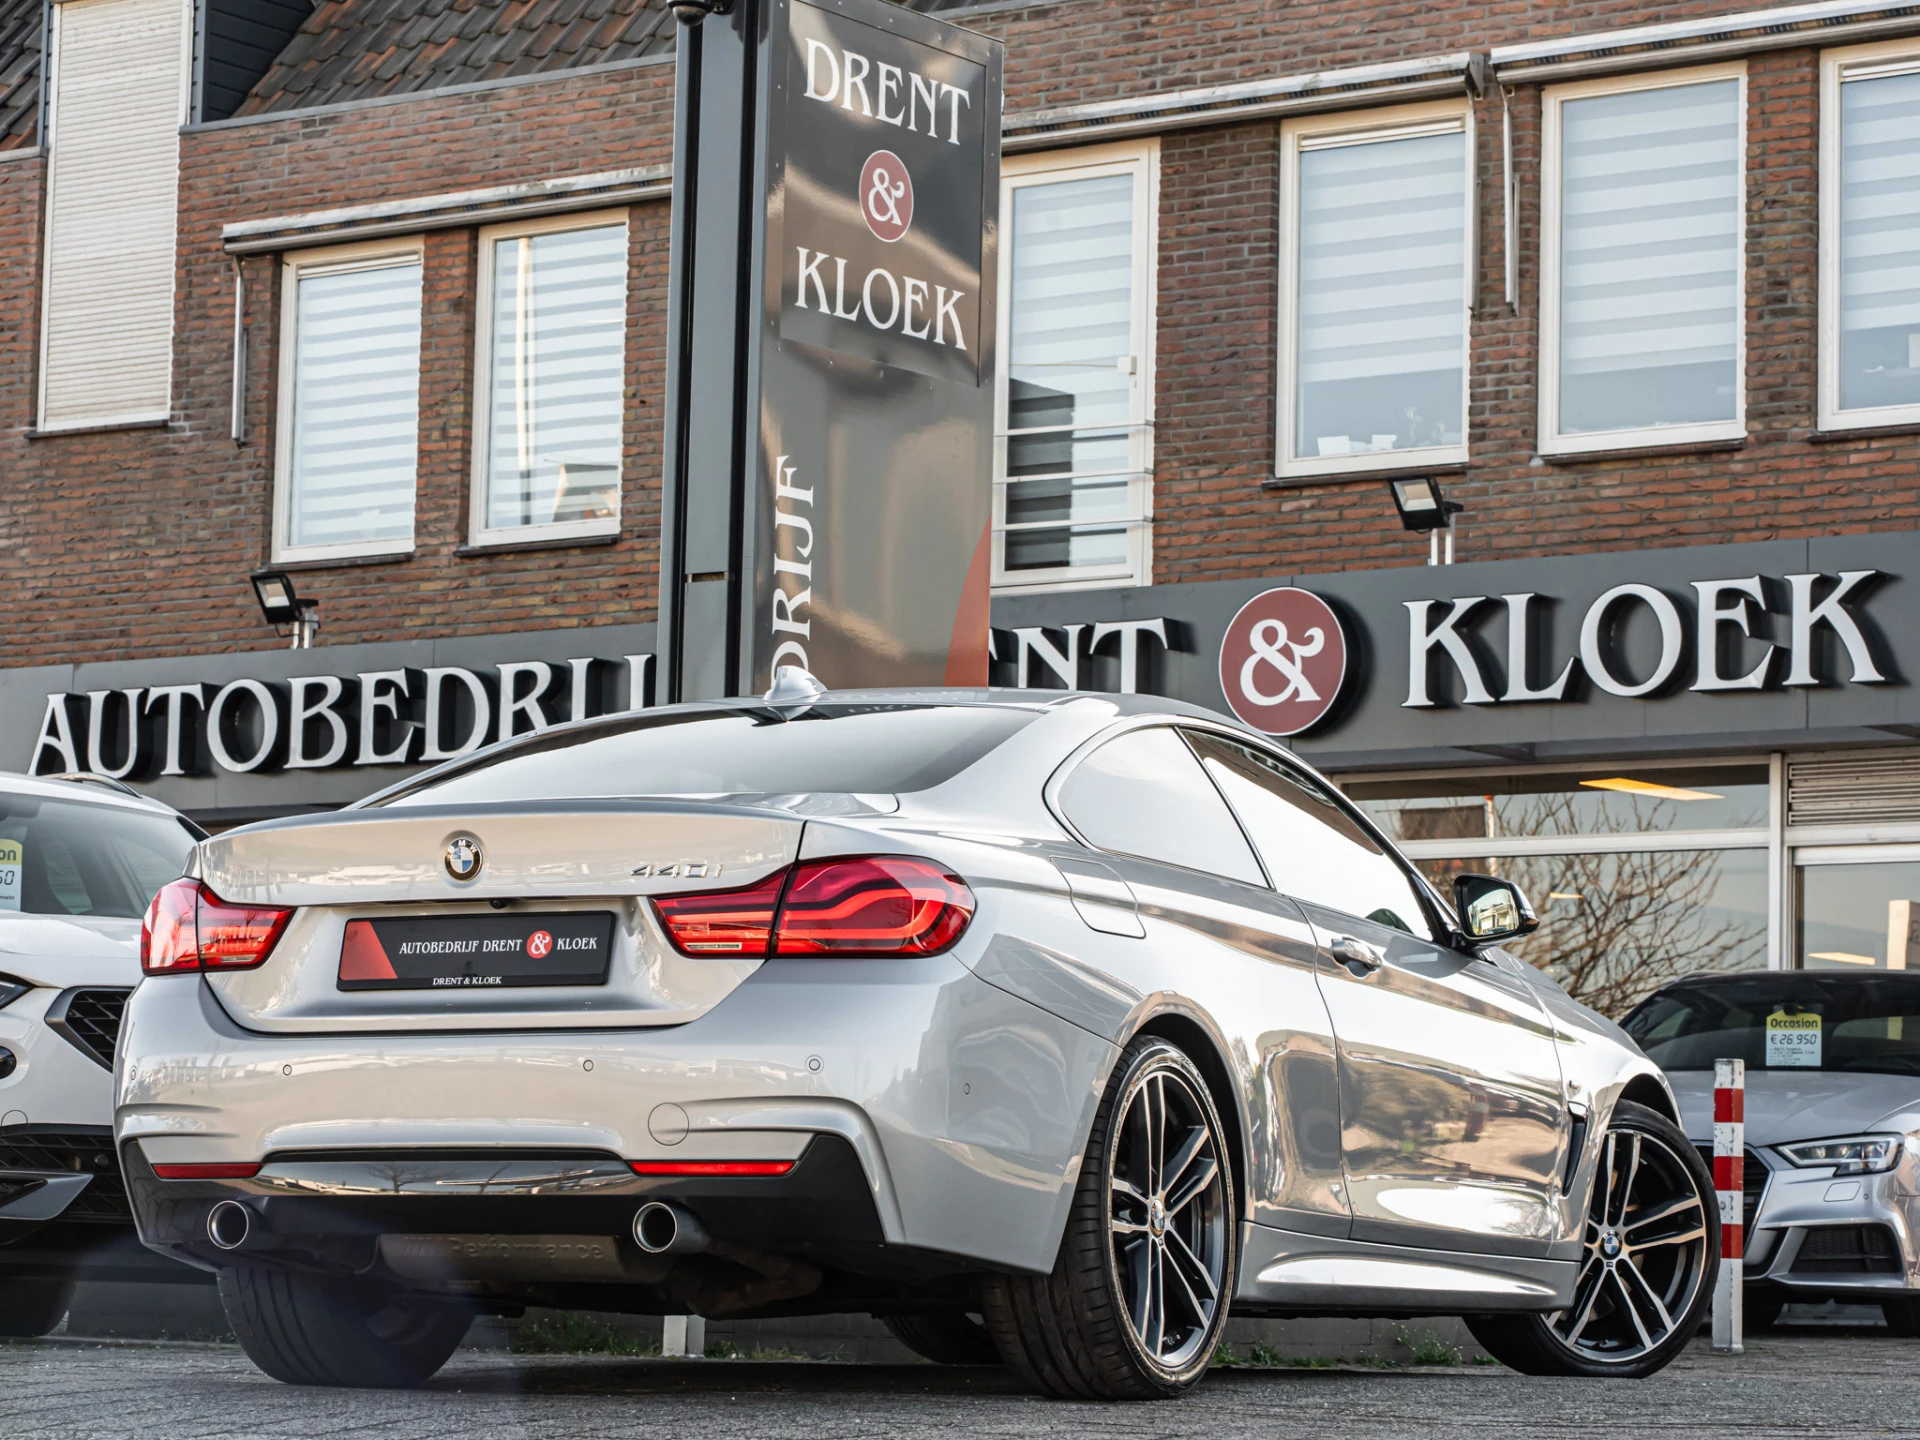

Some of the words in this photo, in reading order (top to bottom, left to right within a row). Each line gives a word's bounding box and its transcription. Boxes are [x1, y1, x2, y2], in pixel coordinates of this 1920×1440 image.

[803, 37, 971, 145] DRENT
[868, 168, 903, 226] &
[795, 246, 967, 350] KLOEK
[989, 617, 1169, 693] NT
[1240, 619, 1325, 706] &
[1402, 569, 1885, 707] KLOEK
[0, 871, 15, 885] 0
[399, 941, 480, 954] AUTOBEDRIJF
[482, 939, 522, 953] DRENT
[531, 934, 549, 955] &
[557, 937, 598, 950] KLOEK
[433, 977, 463, 986] DRENT
[463, 977, 470, 985] &
[472, 976, 502, 985] KLOEK
[1770, 1018, 1818, 1028] Occasion
